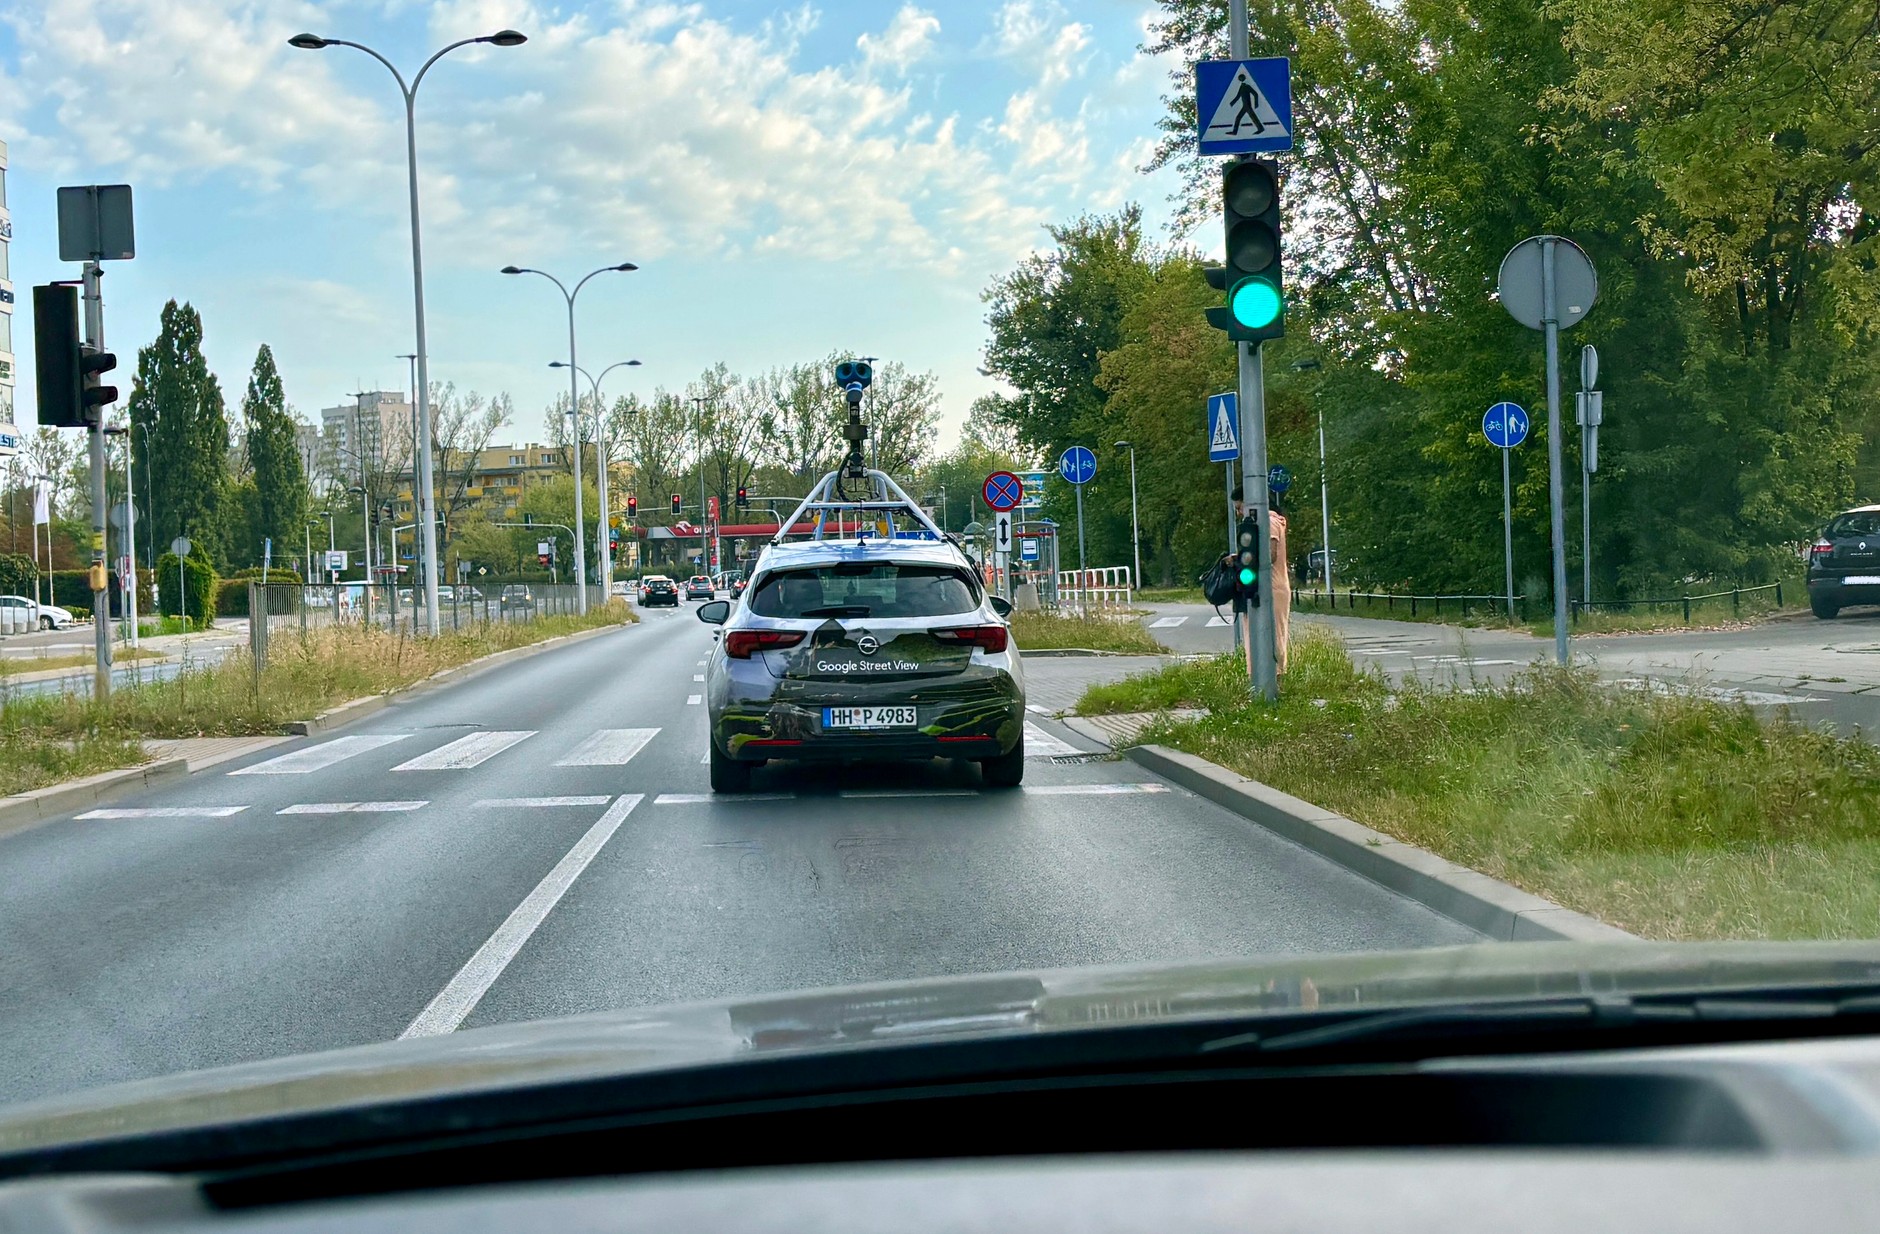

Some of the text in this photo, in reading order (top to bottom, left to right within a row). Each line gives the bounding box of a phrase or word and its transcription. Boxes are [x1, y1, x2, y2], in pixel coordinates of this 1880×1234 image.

[817, 660, 919, 674] Google Street View
[831, 708, 915, 725] HH P 4983
